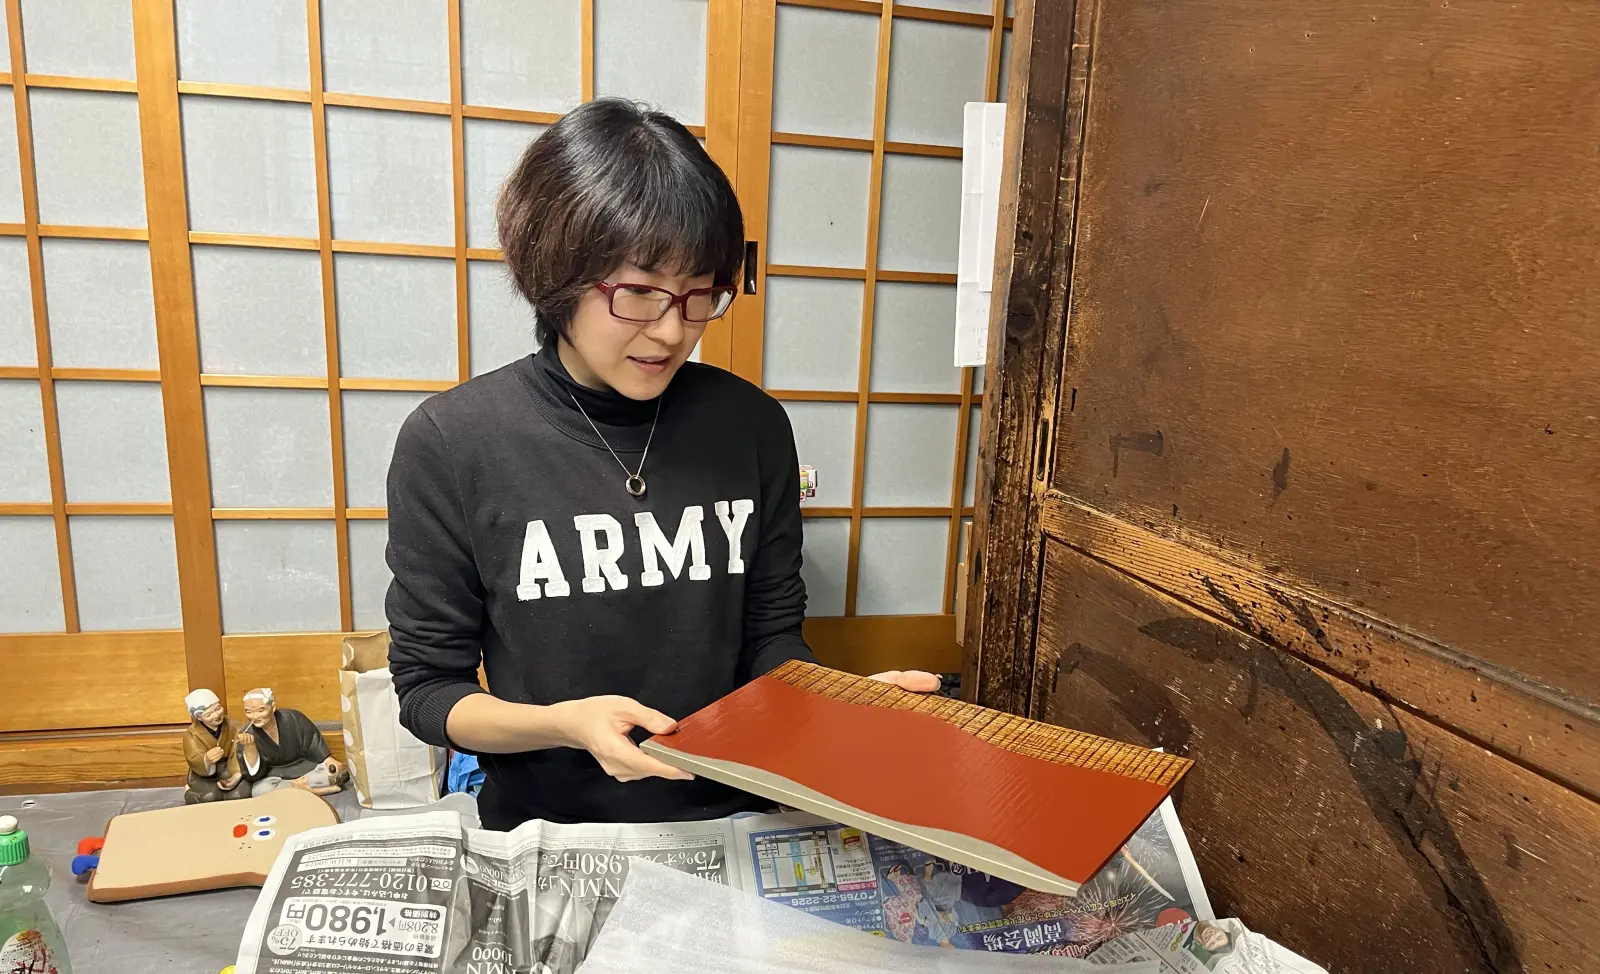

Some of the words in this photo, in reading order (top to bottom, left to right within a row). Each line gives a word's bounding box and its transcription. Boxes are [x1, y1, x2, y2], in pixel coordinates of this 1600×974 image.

[517, 499, 754, 600] ARMY
[290, 872, 427, 889] 0120-777-385
[286, 905, 387, 935] 1,980円
[403, 909, 437, 918] 特別価格
[398, 920, 438, 933] 8,208円
[270, 935, 296, 950] 75%
[305, 934, 434, 953] 驚きの価格で始められます
[982, 921, 1063, 954] 高岡会場
[471, 945, 513, 965] 10000
